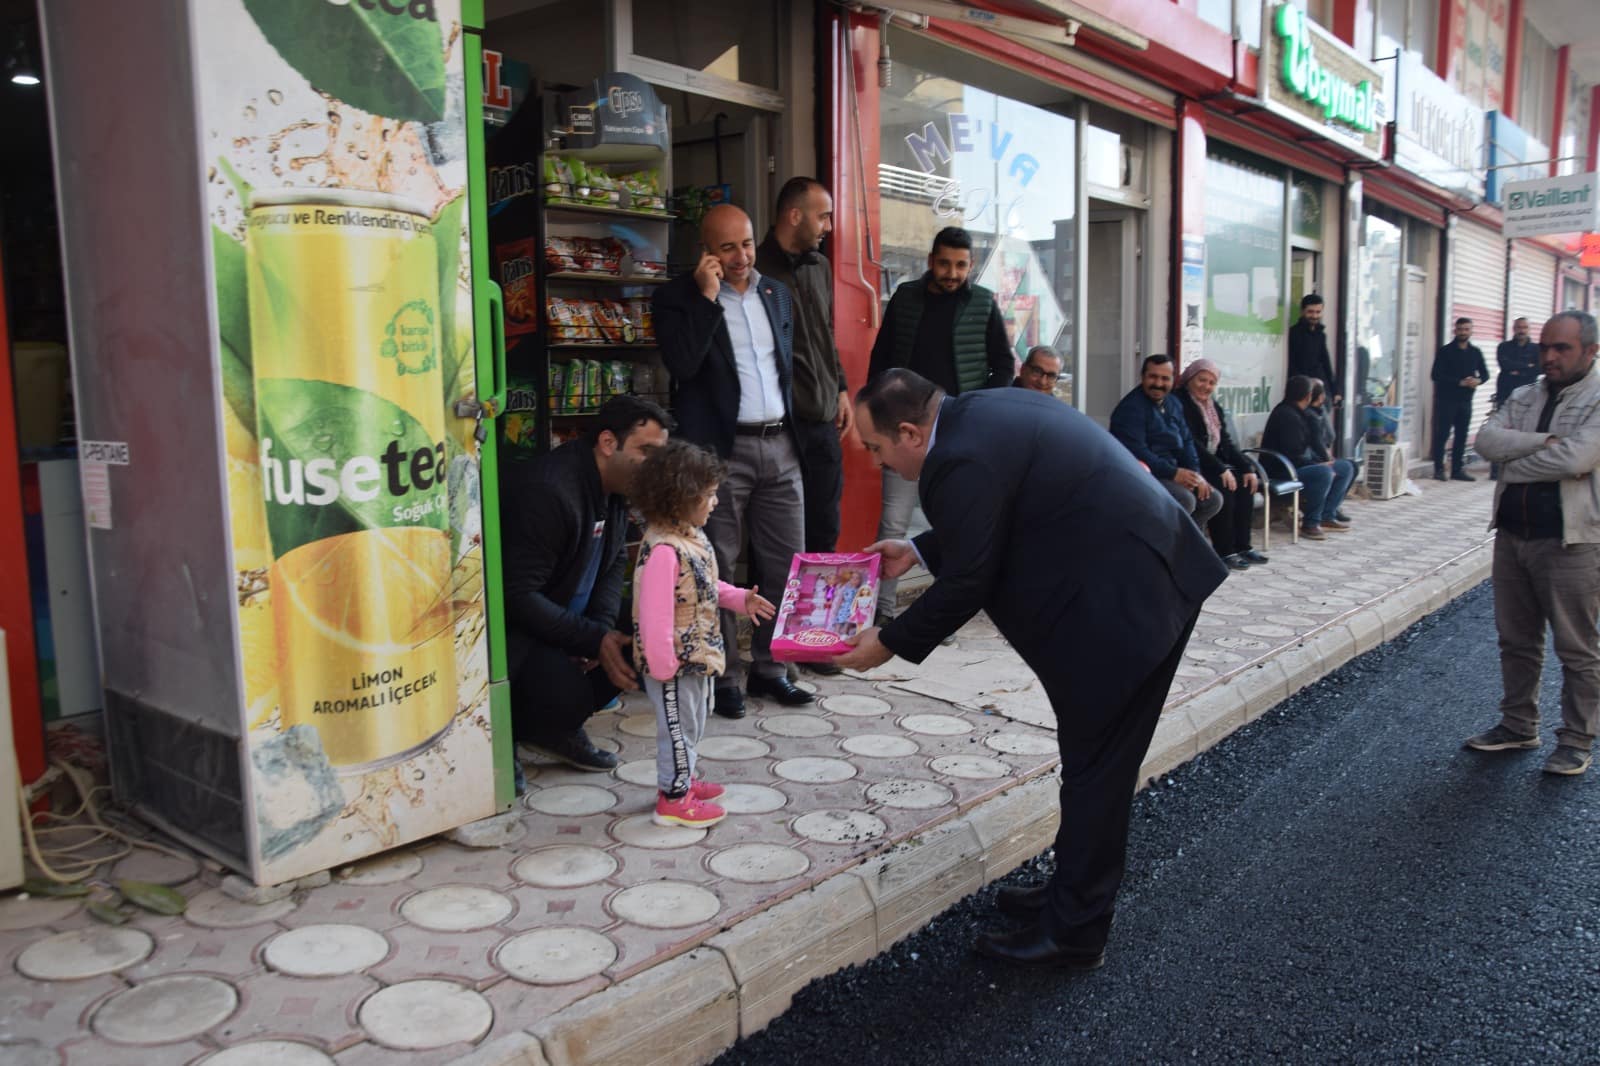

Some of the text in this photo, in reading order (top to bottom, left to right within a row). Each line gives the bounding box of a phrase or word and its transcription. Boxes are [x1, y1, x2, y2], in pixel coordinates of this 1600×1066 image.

[1526, 184, 1592, 209] Vaillant
[293, 213, 311, 225] ve
[314, 209, 412, 231] Renklendirici
[351, 665, 404, 691] LİMON
[313, 671, 437, 714] AROMALI İÇECEK
[665, 701, 679, 723] HAVE
[669, 723, 682, 741] FUN
